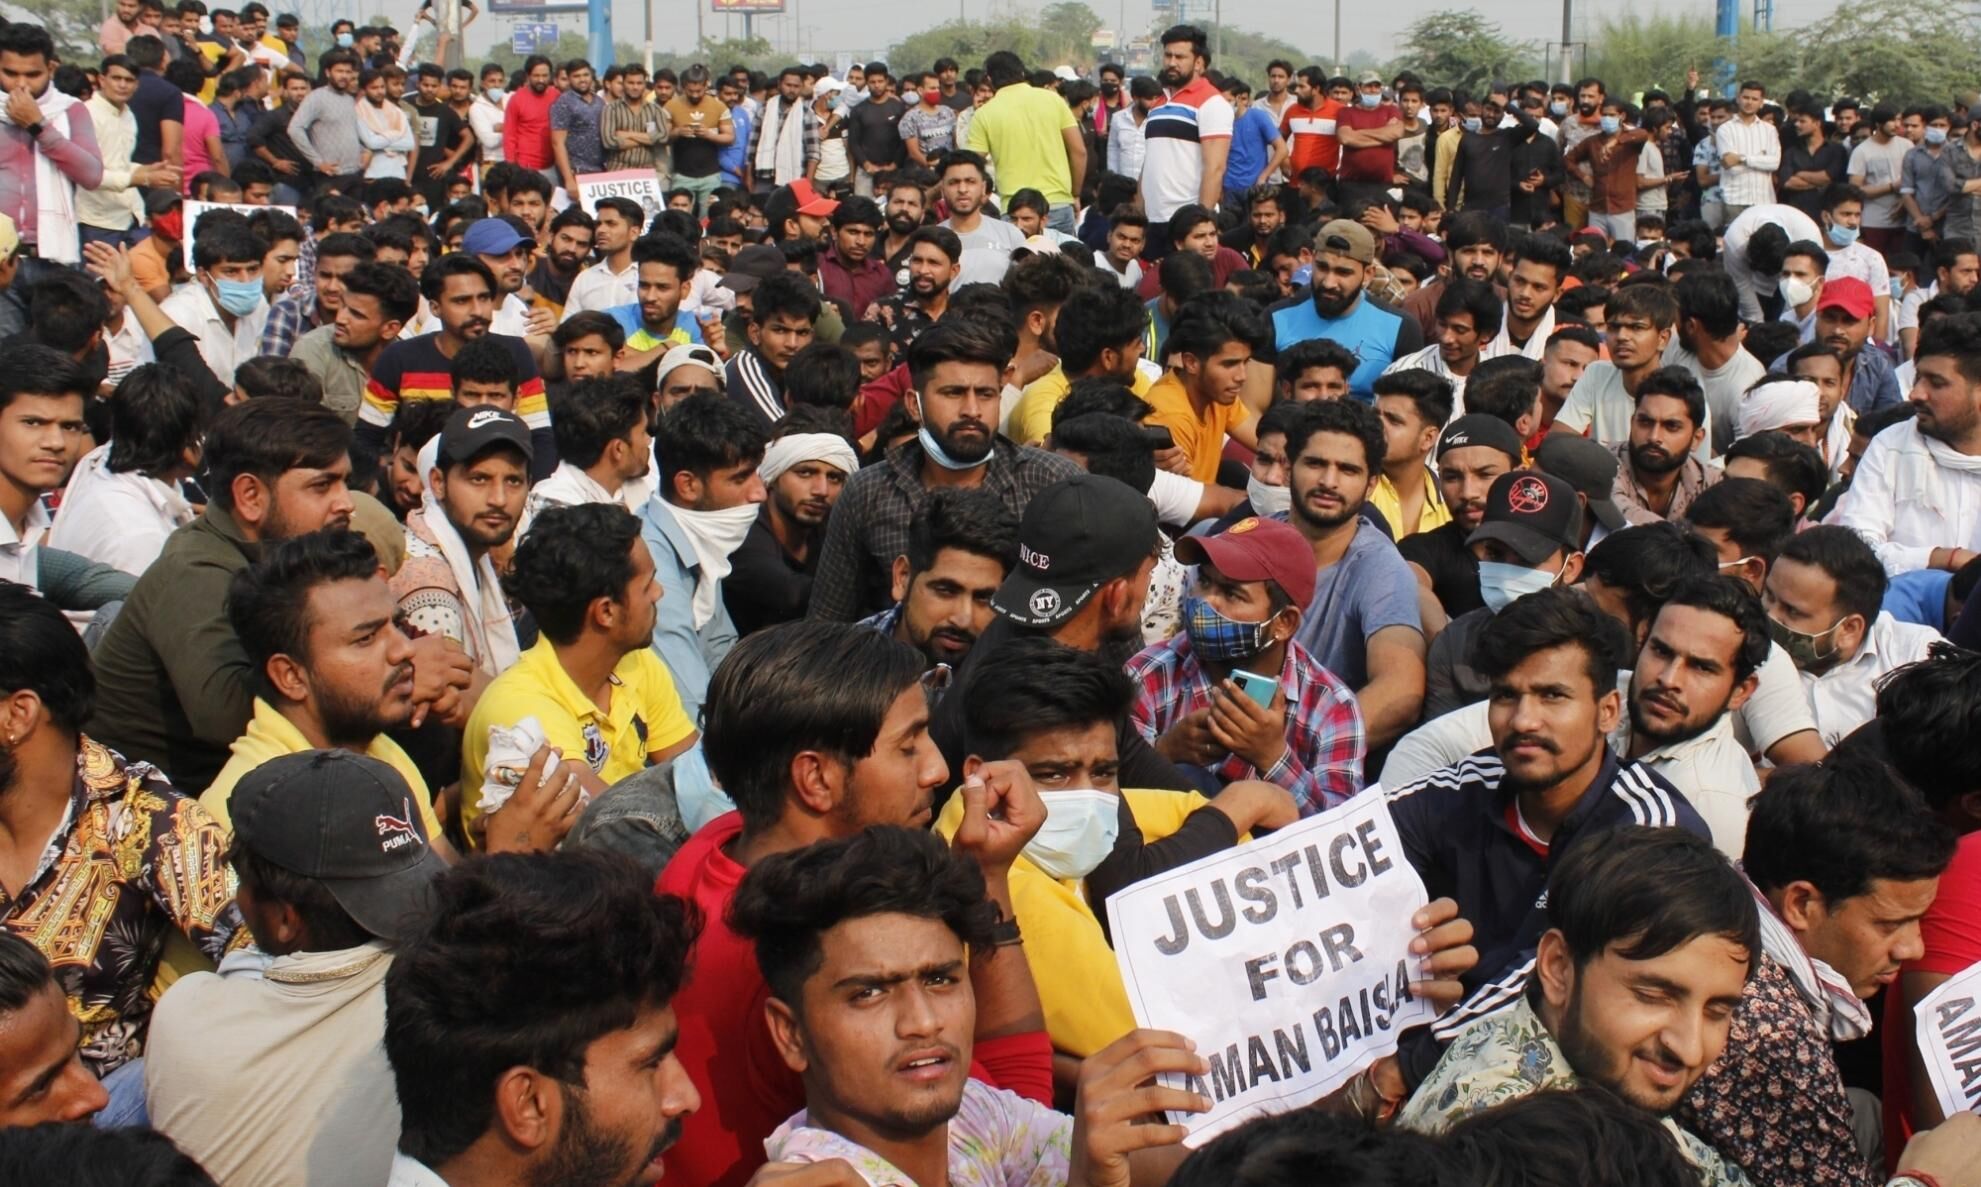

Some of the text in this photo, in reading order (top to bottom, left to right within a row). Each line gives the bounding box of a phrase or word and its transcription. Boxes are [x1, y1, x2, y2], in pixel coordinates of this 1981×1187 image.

[587, 181, 653, 199] JUSTICE
[473, 410, 501, 421] NIKE
[1019, 543, 1050, 570] NICE
[1035, 596, 1054, 610] NY
[382, 832, 412, 852] PUMA
[1153, 819, 1394, 956] JUSTICE
[1244, 922, 1364, 1001] FOR
